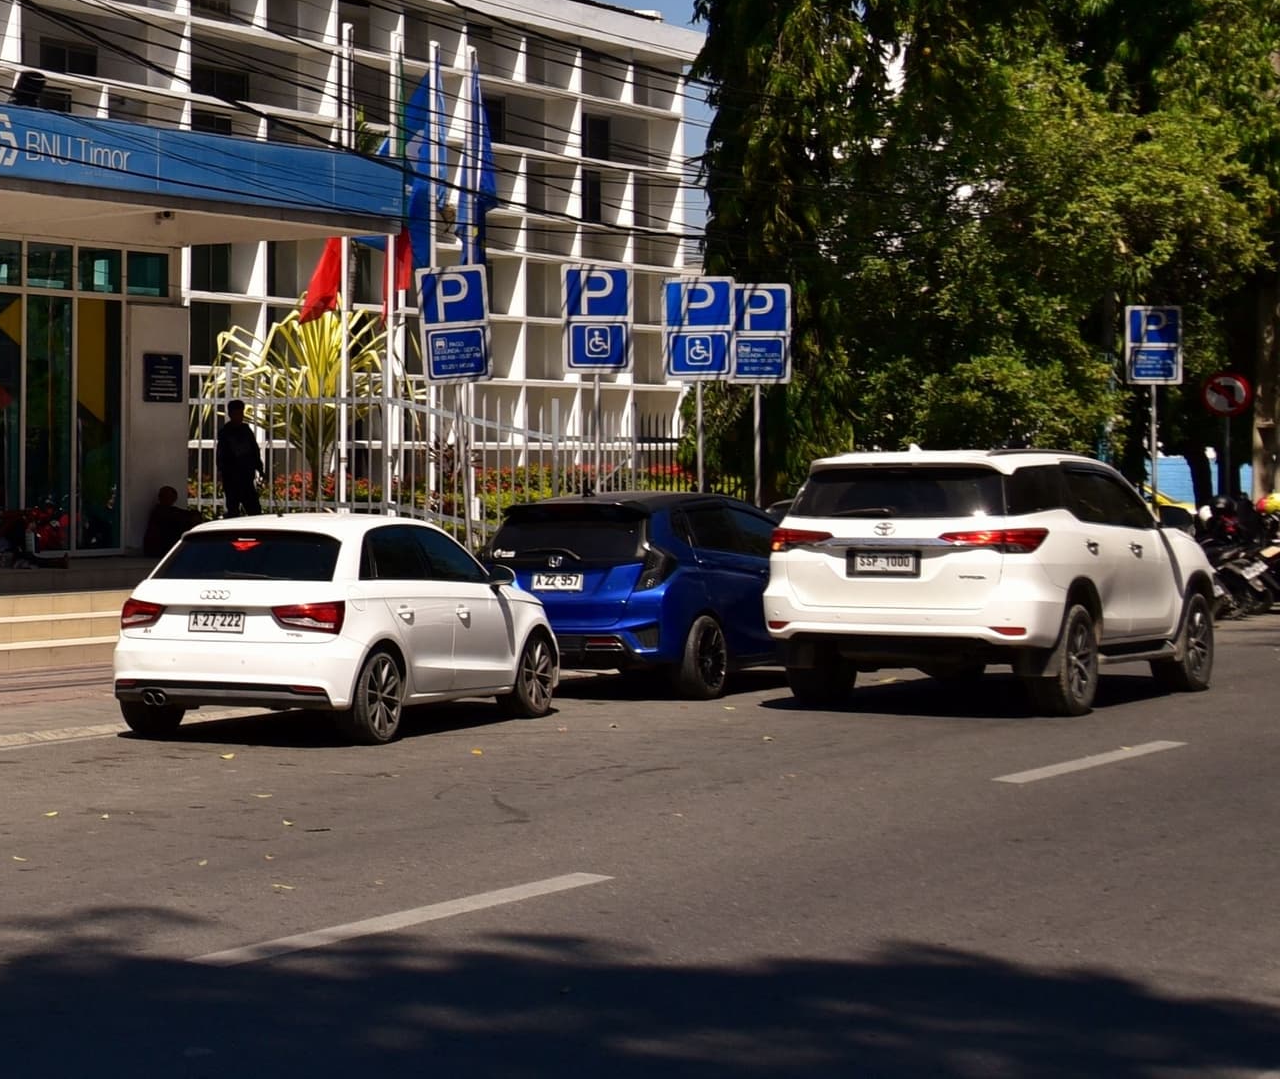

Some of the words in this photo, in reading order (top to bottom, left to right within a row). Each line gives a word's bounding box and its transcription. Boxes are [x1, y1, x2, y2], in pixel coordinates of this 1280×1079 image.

[25, 131, 72, 166] BNU
[76, 137, 131, 171] Timor
[435, 273, 469, 322] P
[580, 270, 614, 315] P
[680, 282, 715, 326] P
[743, 289, 774, 330] P
[1141, 310, 1167, 343] P
